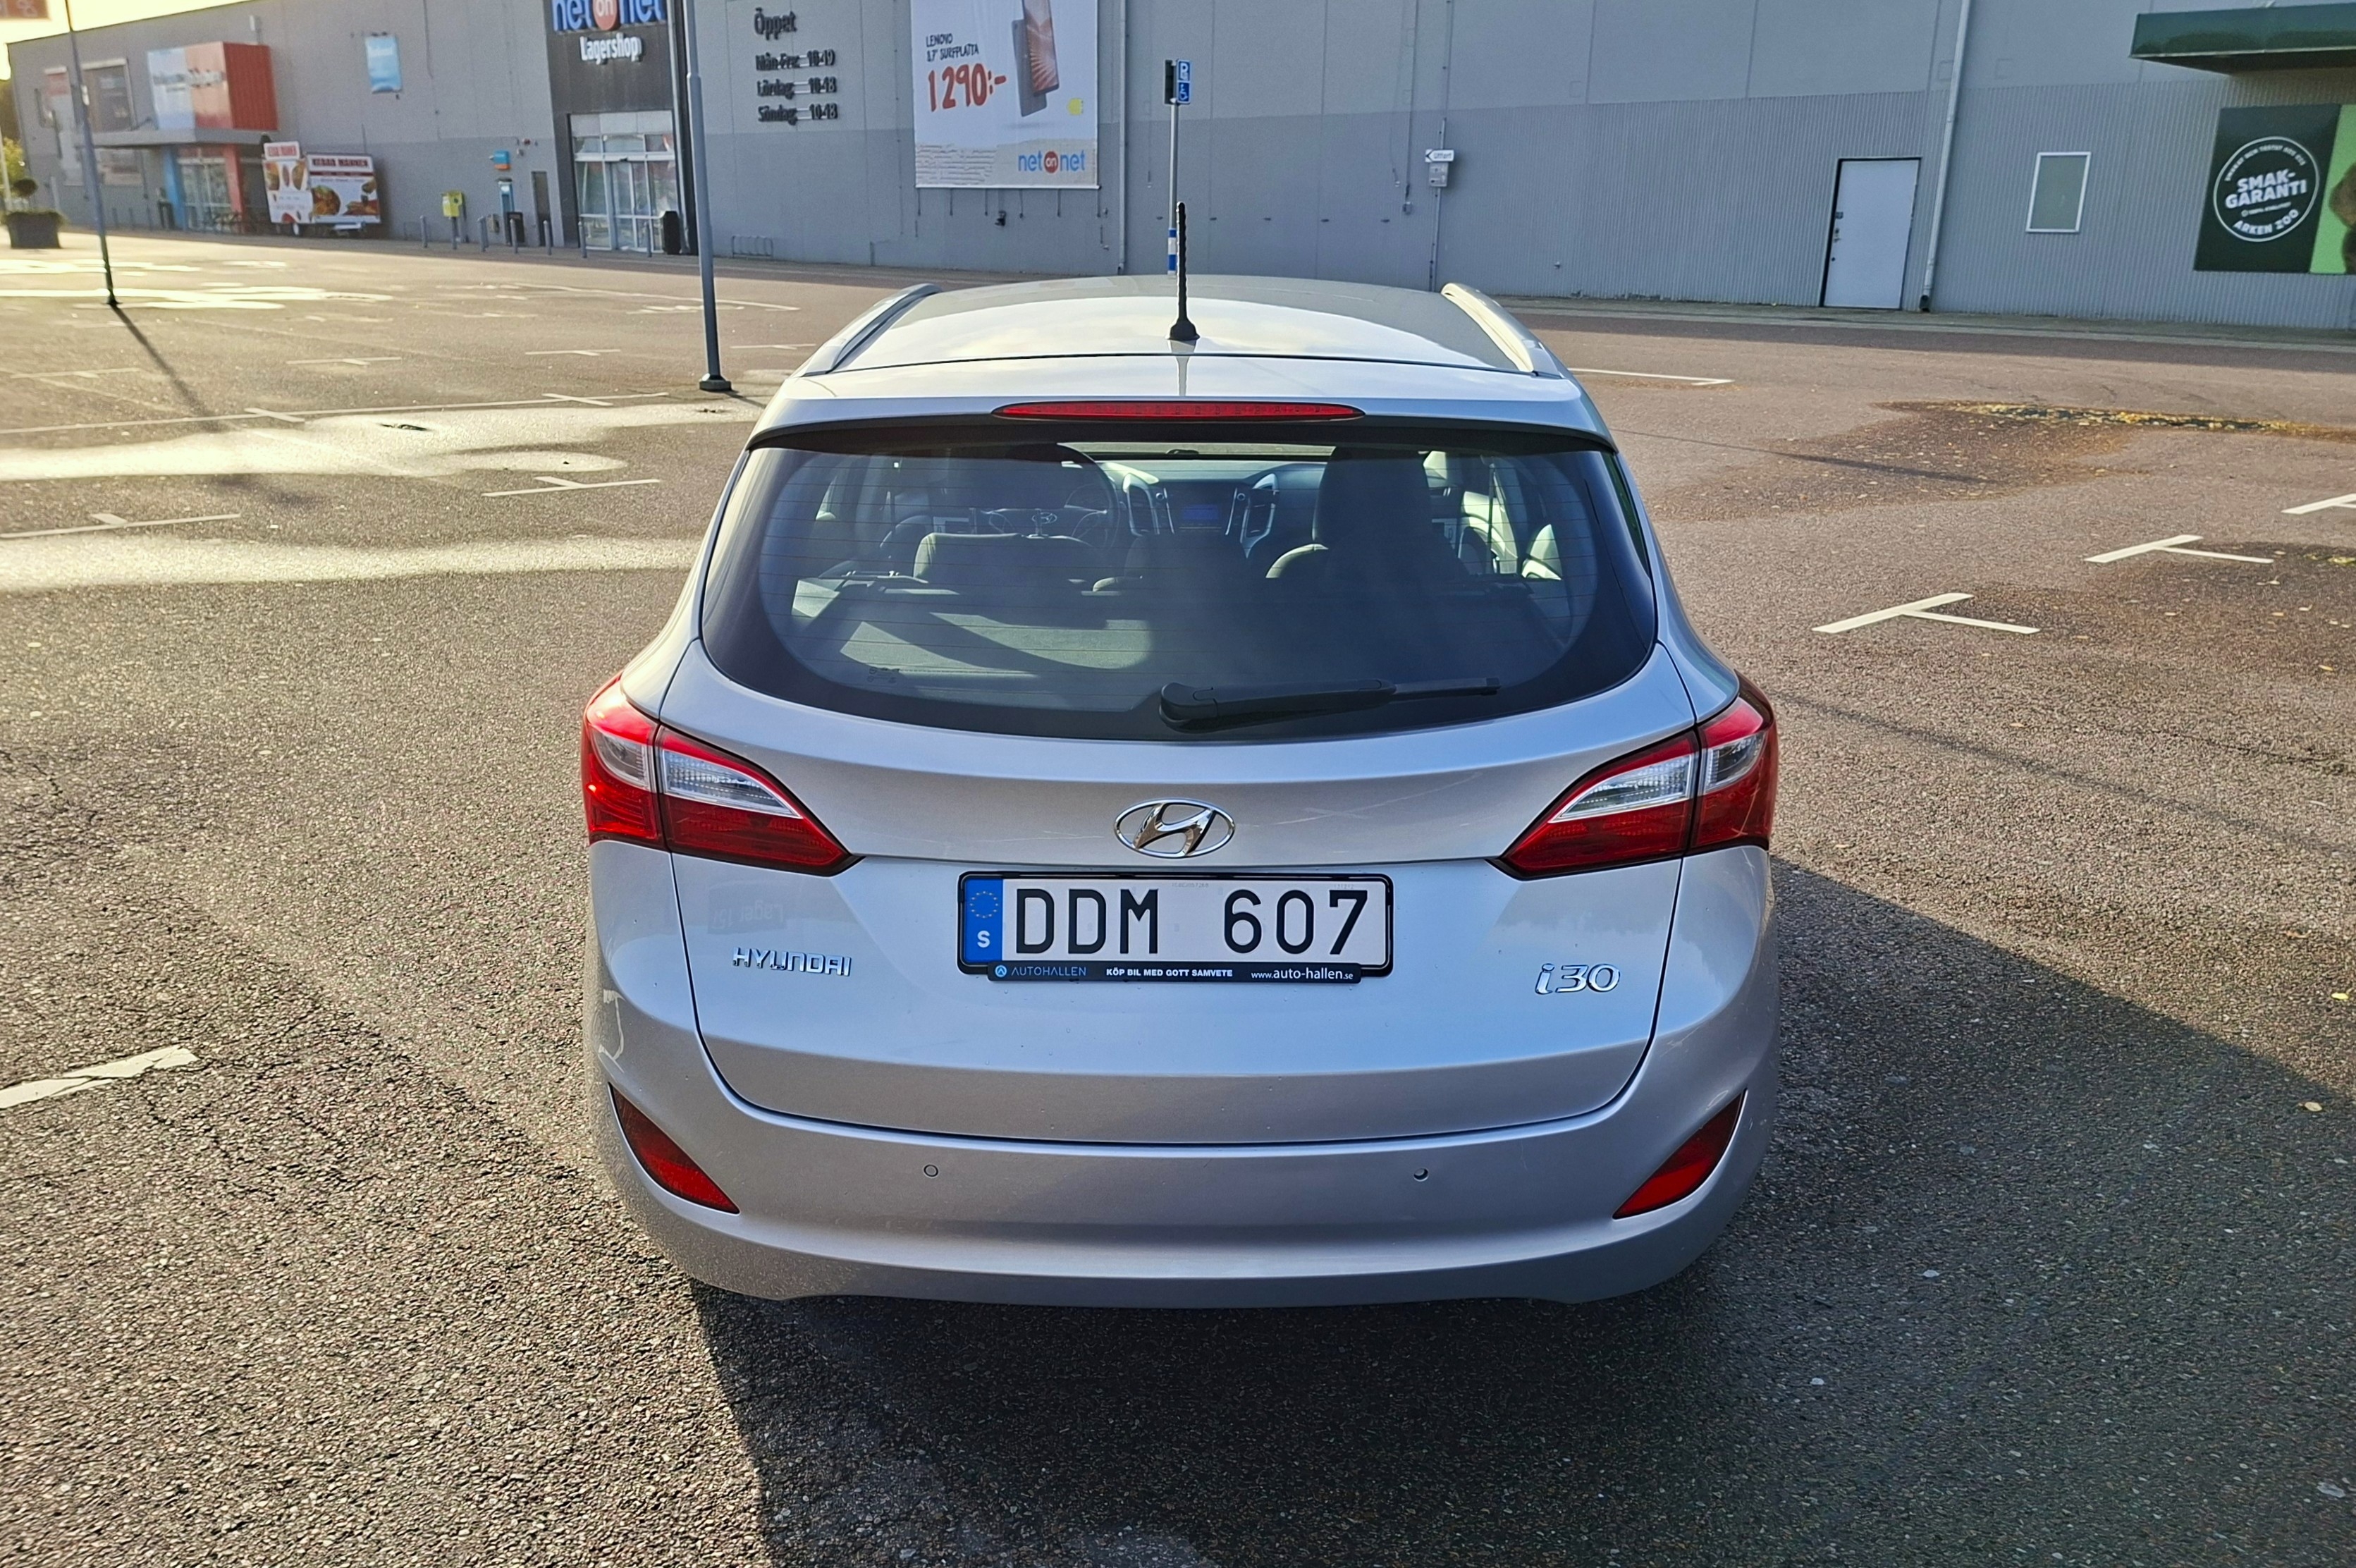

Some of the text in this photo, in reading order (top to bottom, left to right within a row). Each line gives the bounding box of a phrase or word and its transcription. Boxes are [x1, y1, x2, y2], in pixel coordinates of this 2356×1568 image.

[754, 7, 797, 40] Öppet
[579, 32, 642, 65] Lagershop
[926, 33, 953, 47] LENOVO
[809, 103, 839, 121] 10-18
[2237, 169, 2296, 193] SMAK-
[2225, 179, 2307, 209] GARANTI
[2232, 209, 2300, 235] ARKEN ZOO
[1017, 888, 1368, 955] DDM 607
[977, 930, 990, 948] S
[732, 947, 852, 976] HYUNDAI
[1011, 966, 1086, 976] AUTOHALLEN
[1106, 967, 1233, 978] KÖP BIL MED GOTT SAMVETE
[1251, 967, 1354, 980] www.auto-hallen.se
[1535, 963, 1621, 995] i30
